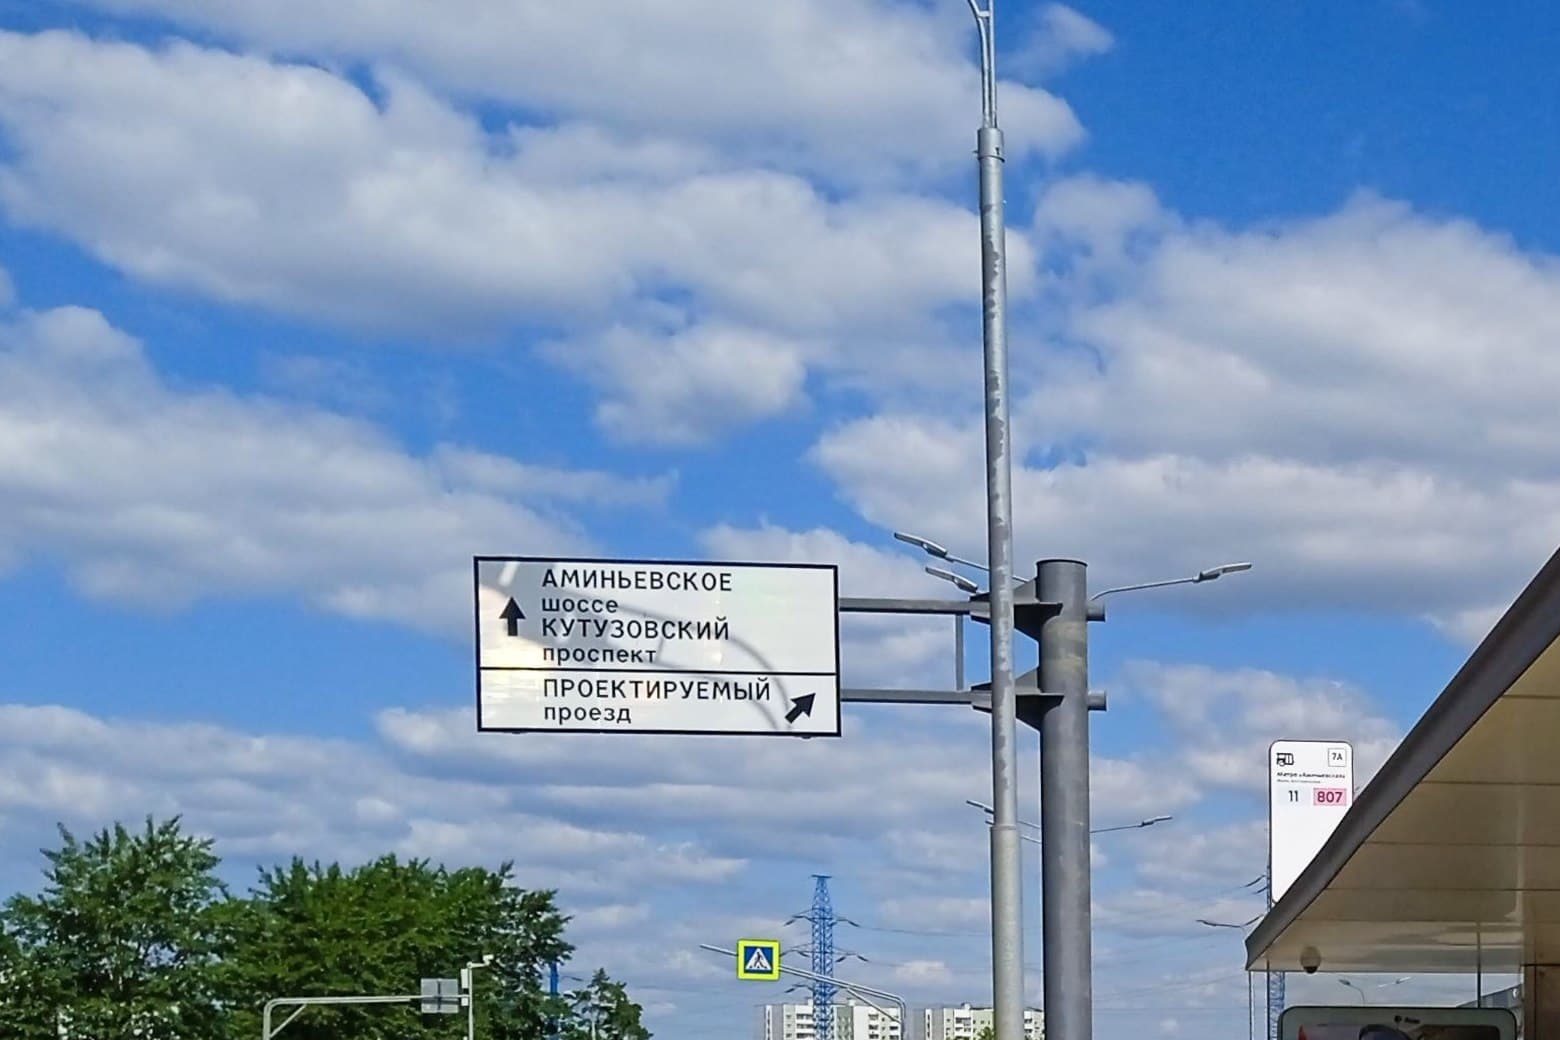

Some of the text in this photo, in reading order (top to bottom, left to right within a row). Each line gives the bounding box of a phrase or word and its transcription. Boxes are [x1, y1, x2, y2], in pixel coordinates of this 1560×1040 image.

[541, 568, 733, 593] АМИНЬЕВСКОЕ
[541, 597, 619, 614] шоссе
[541, 616, 730, 641] КУТУЗОВСКИЙ
[542, 646, 657, 667] проспект
[543, 676, 771, 701] ПРОЕКТИРУЕМЫЙ
[544, 704, 632, 726] проезд
[1288, 790, 1343, 803] 11 807
